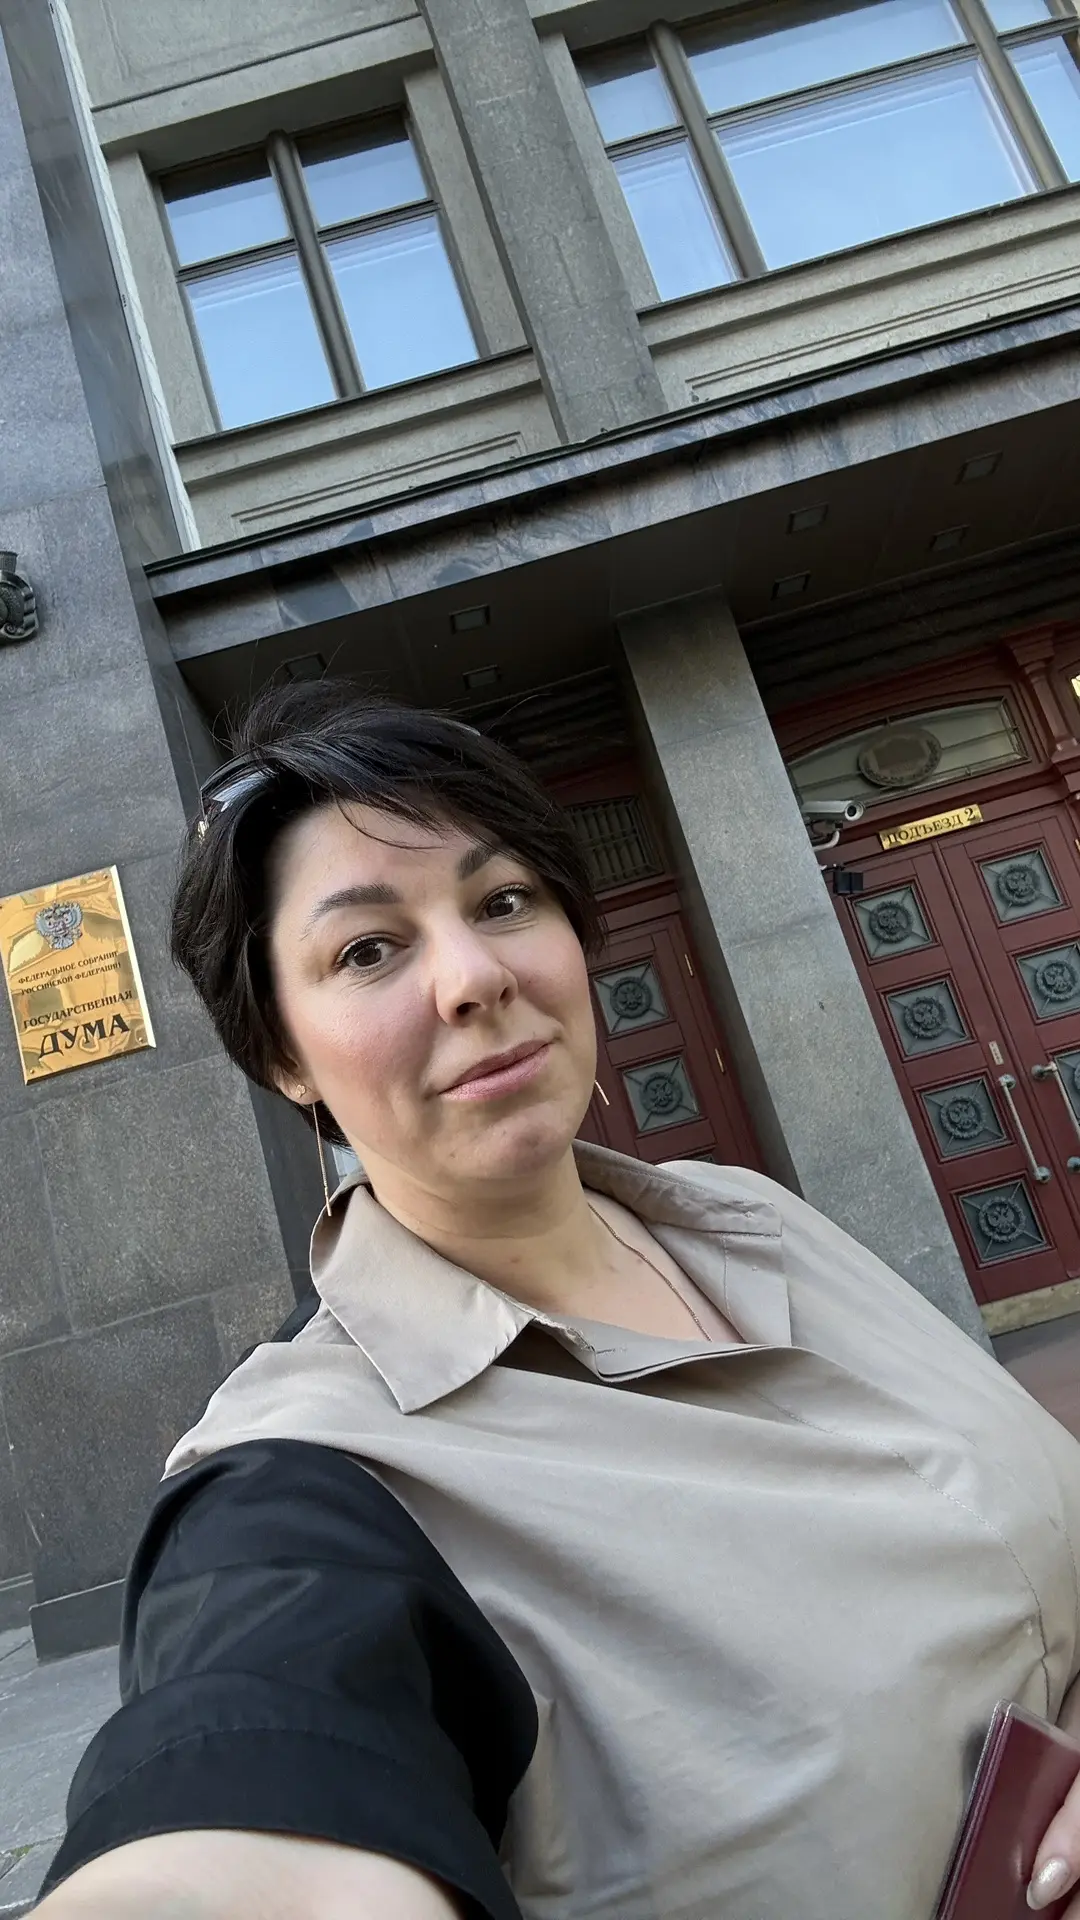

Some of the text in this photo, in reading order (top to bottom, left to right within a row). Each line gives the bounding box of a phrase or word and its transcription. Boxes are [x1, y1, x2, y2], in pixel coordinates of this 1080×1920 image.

[886, 807, 977, 846] ПОДЪЕЗД 2
[18, 961, 76, 985] ФЕДЕРАЛЬНОЕ
[23, 990, 133, 1029] ГОСУДАРСТВЕННАЯ
[38, 1013, 130, 1059] ДУМА
